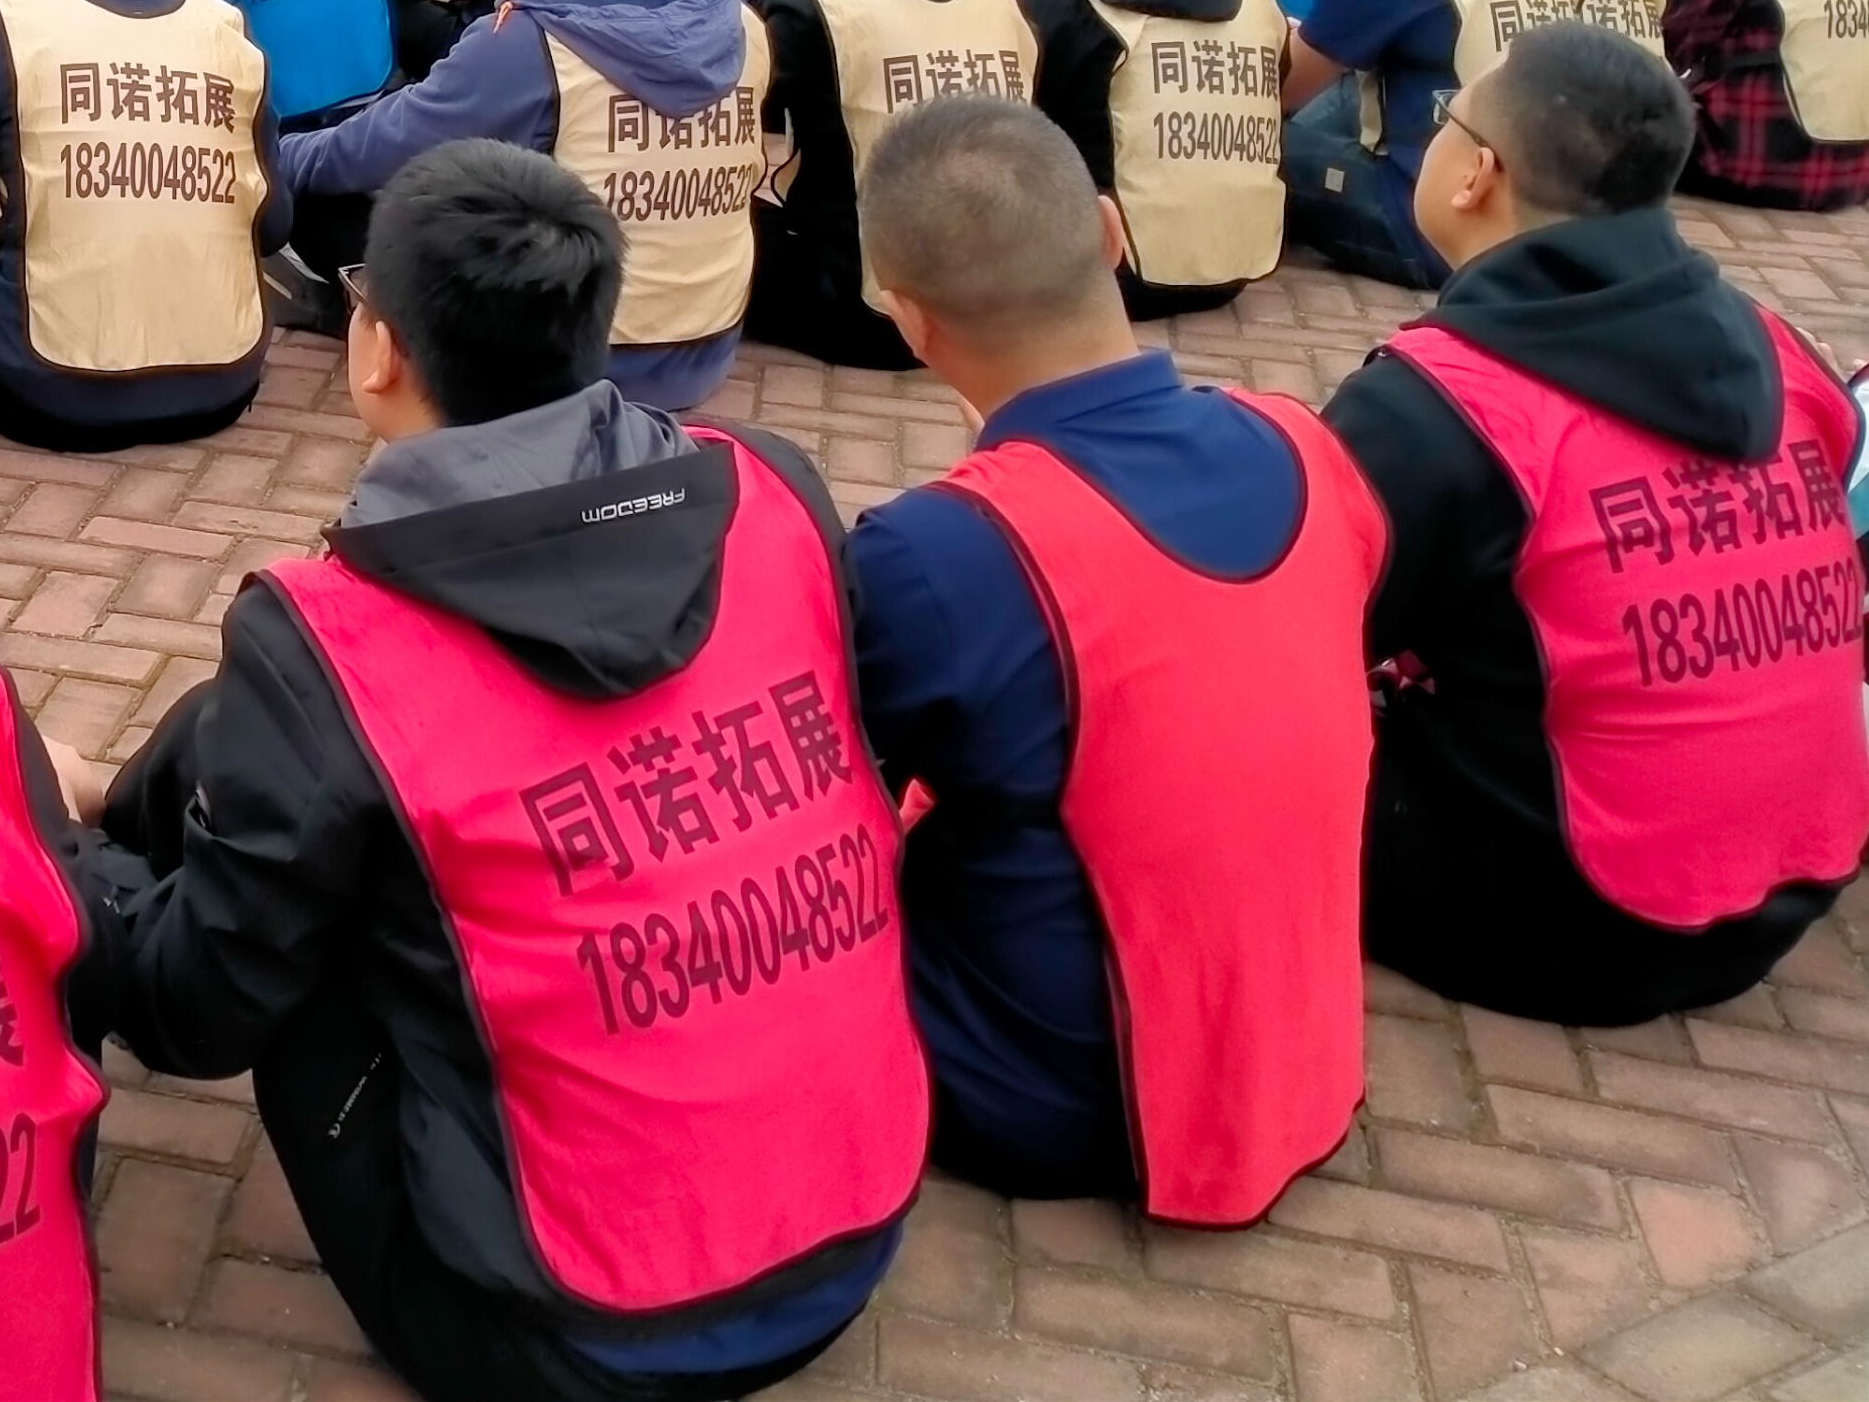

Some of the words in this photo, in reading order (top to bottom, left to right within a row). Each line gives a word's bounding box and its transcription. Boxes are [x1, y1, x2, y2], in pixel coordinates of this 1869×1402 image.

[58, 61, 236, 134] 同诺拓展
[883, 48, 1028, 114] 同诺拓展
[1151, 39, 1278, 101] 同诺拓展
[1153, 111, 1279, 165] 18340048522
[60, 141, 236, 204] 18340048522
[603, 163, 753, 221] 18340048522
[581, 487, 686, 523] FREEDOM
[1588, 438, 1847, 574] 同诺拓展
[1622, 556, 1862, 687] 18340048522
[519, 669, 854, 898] 同诺拓展
[576, 823, 889, 1036] 18340048522
